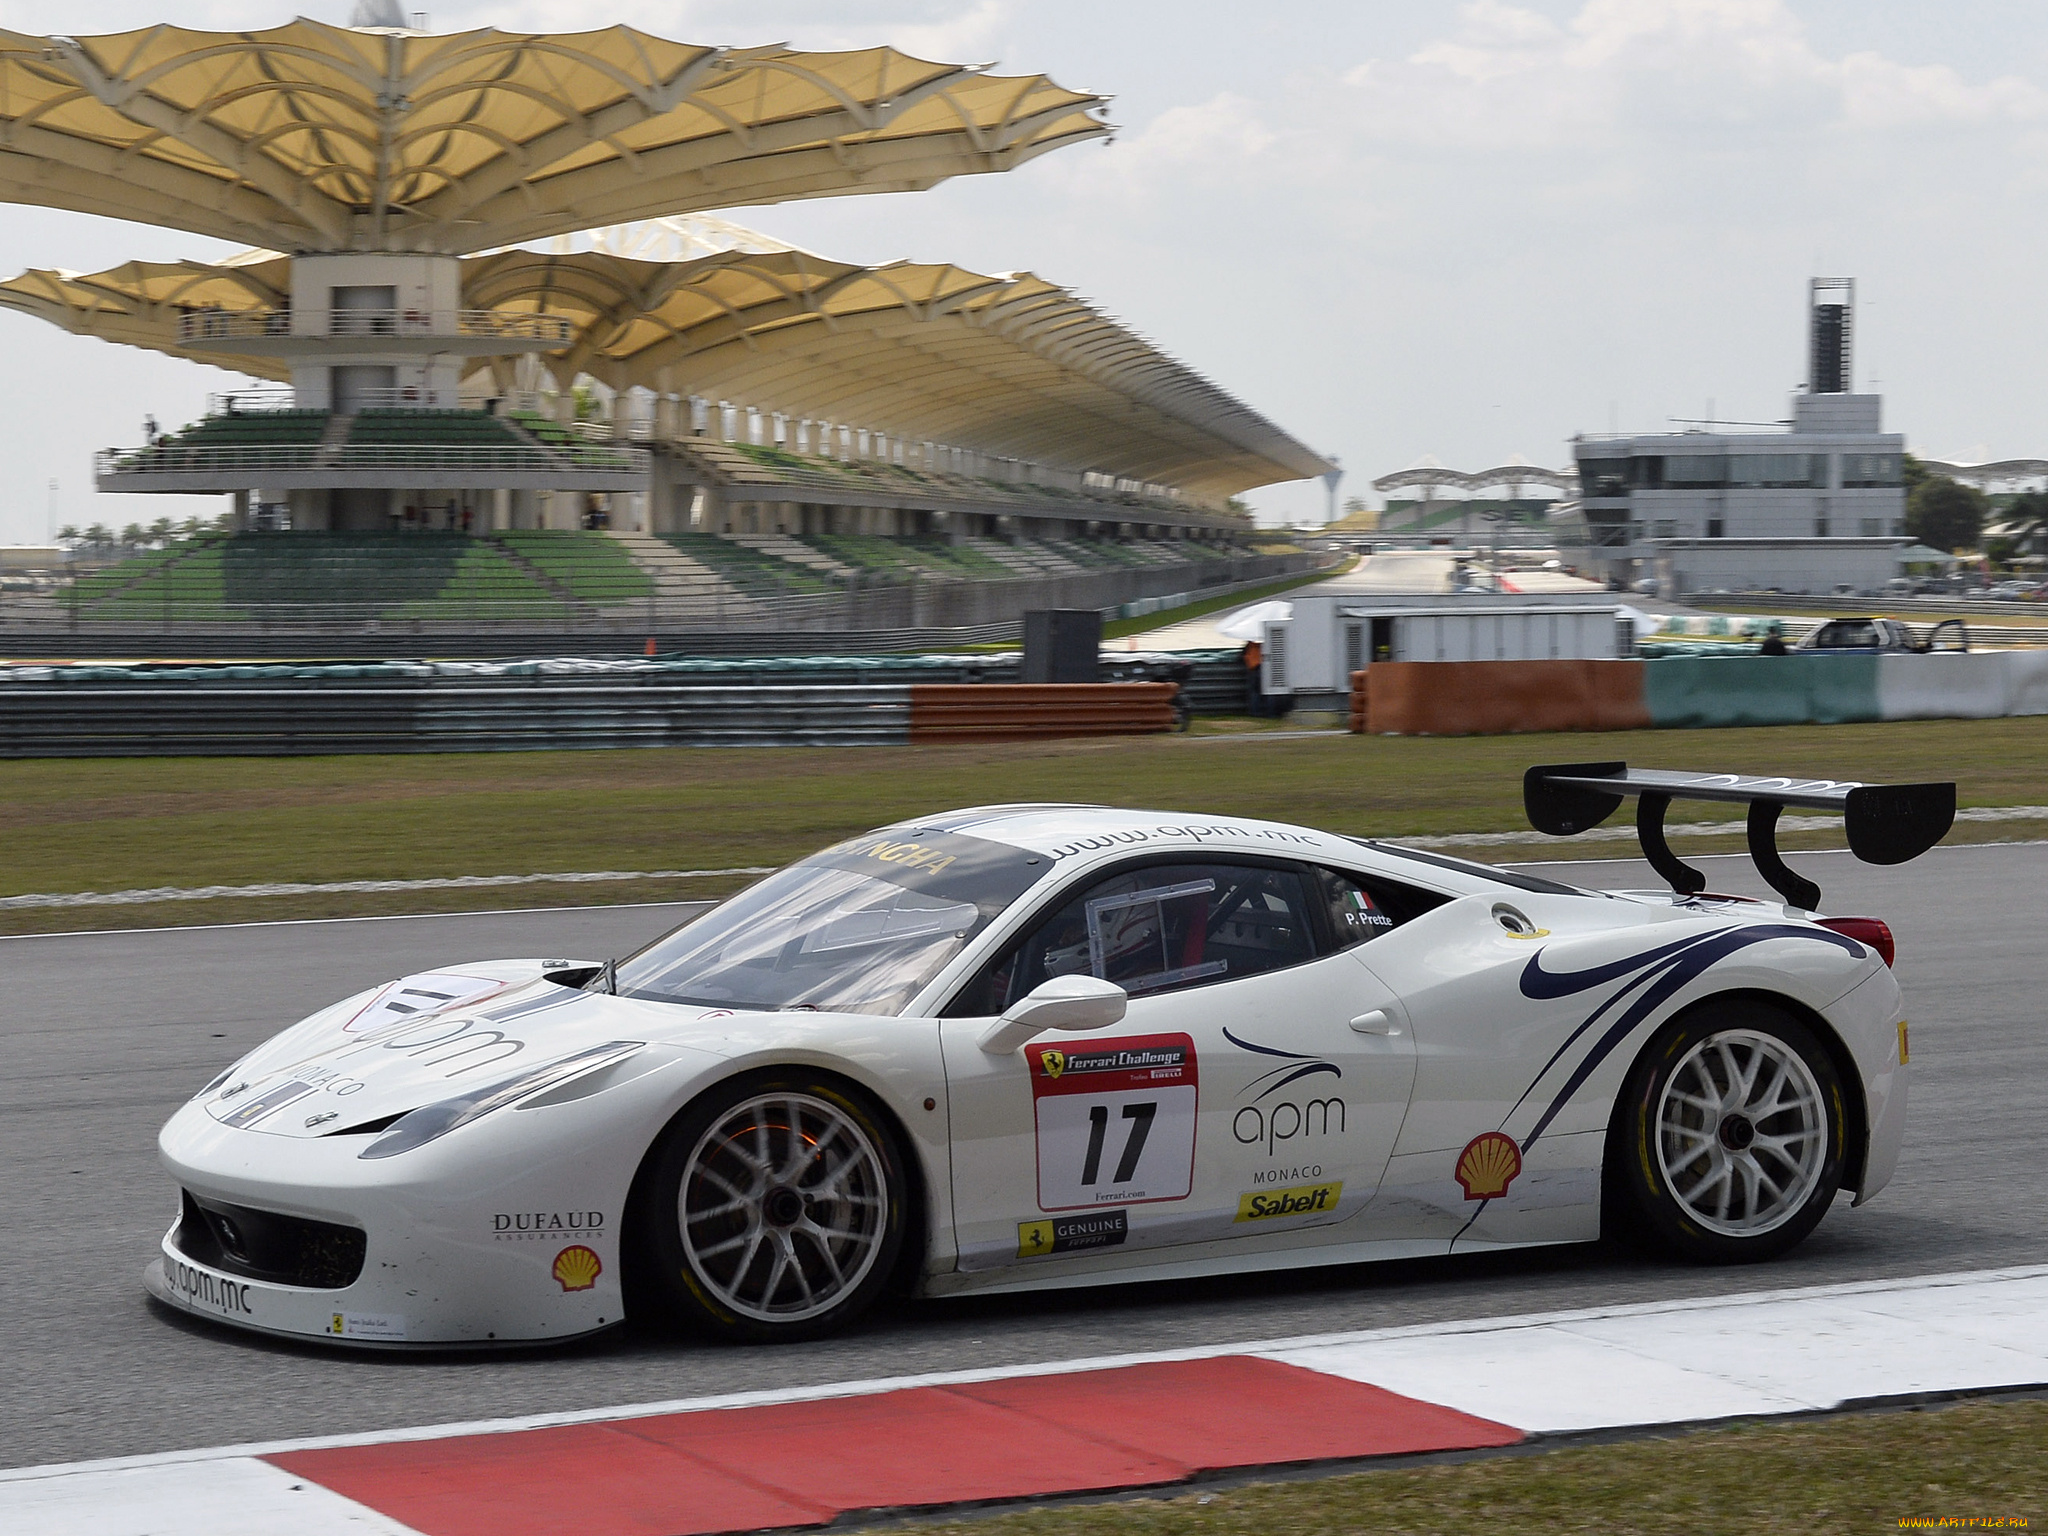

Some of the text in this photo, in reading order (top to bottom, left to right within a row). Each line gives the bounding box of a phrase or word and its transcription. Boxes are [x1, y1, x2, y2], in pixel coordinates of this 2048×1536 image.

[1046, 825, 1322, 861] www.apm.mc
[1345, 912, 1394, 926] P. Prette
[1068, 1051, 1181, 1069] Ferrari Challenge
[1150, 1068, 1182, 1080] PIRELLI
[1232, 1097, 1345, 1157] apm
[1081, 1102, 1158, 1186] 17
[1253, 1165, 1322, 1185] MONACO
[1095, 1190, 1146, 1202] Ferrari.com
[1248, 1188, 1330, 1218] Sabelt
[494, 1211, 604, 1231] DUFAUD
[1057, 1218, 1123, 1237] GENUINE
[494, 1231, 603, 1242] ASSURANCES
